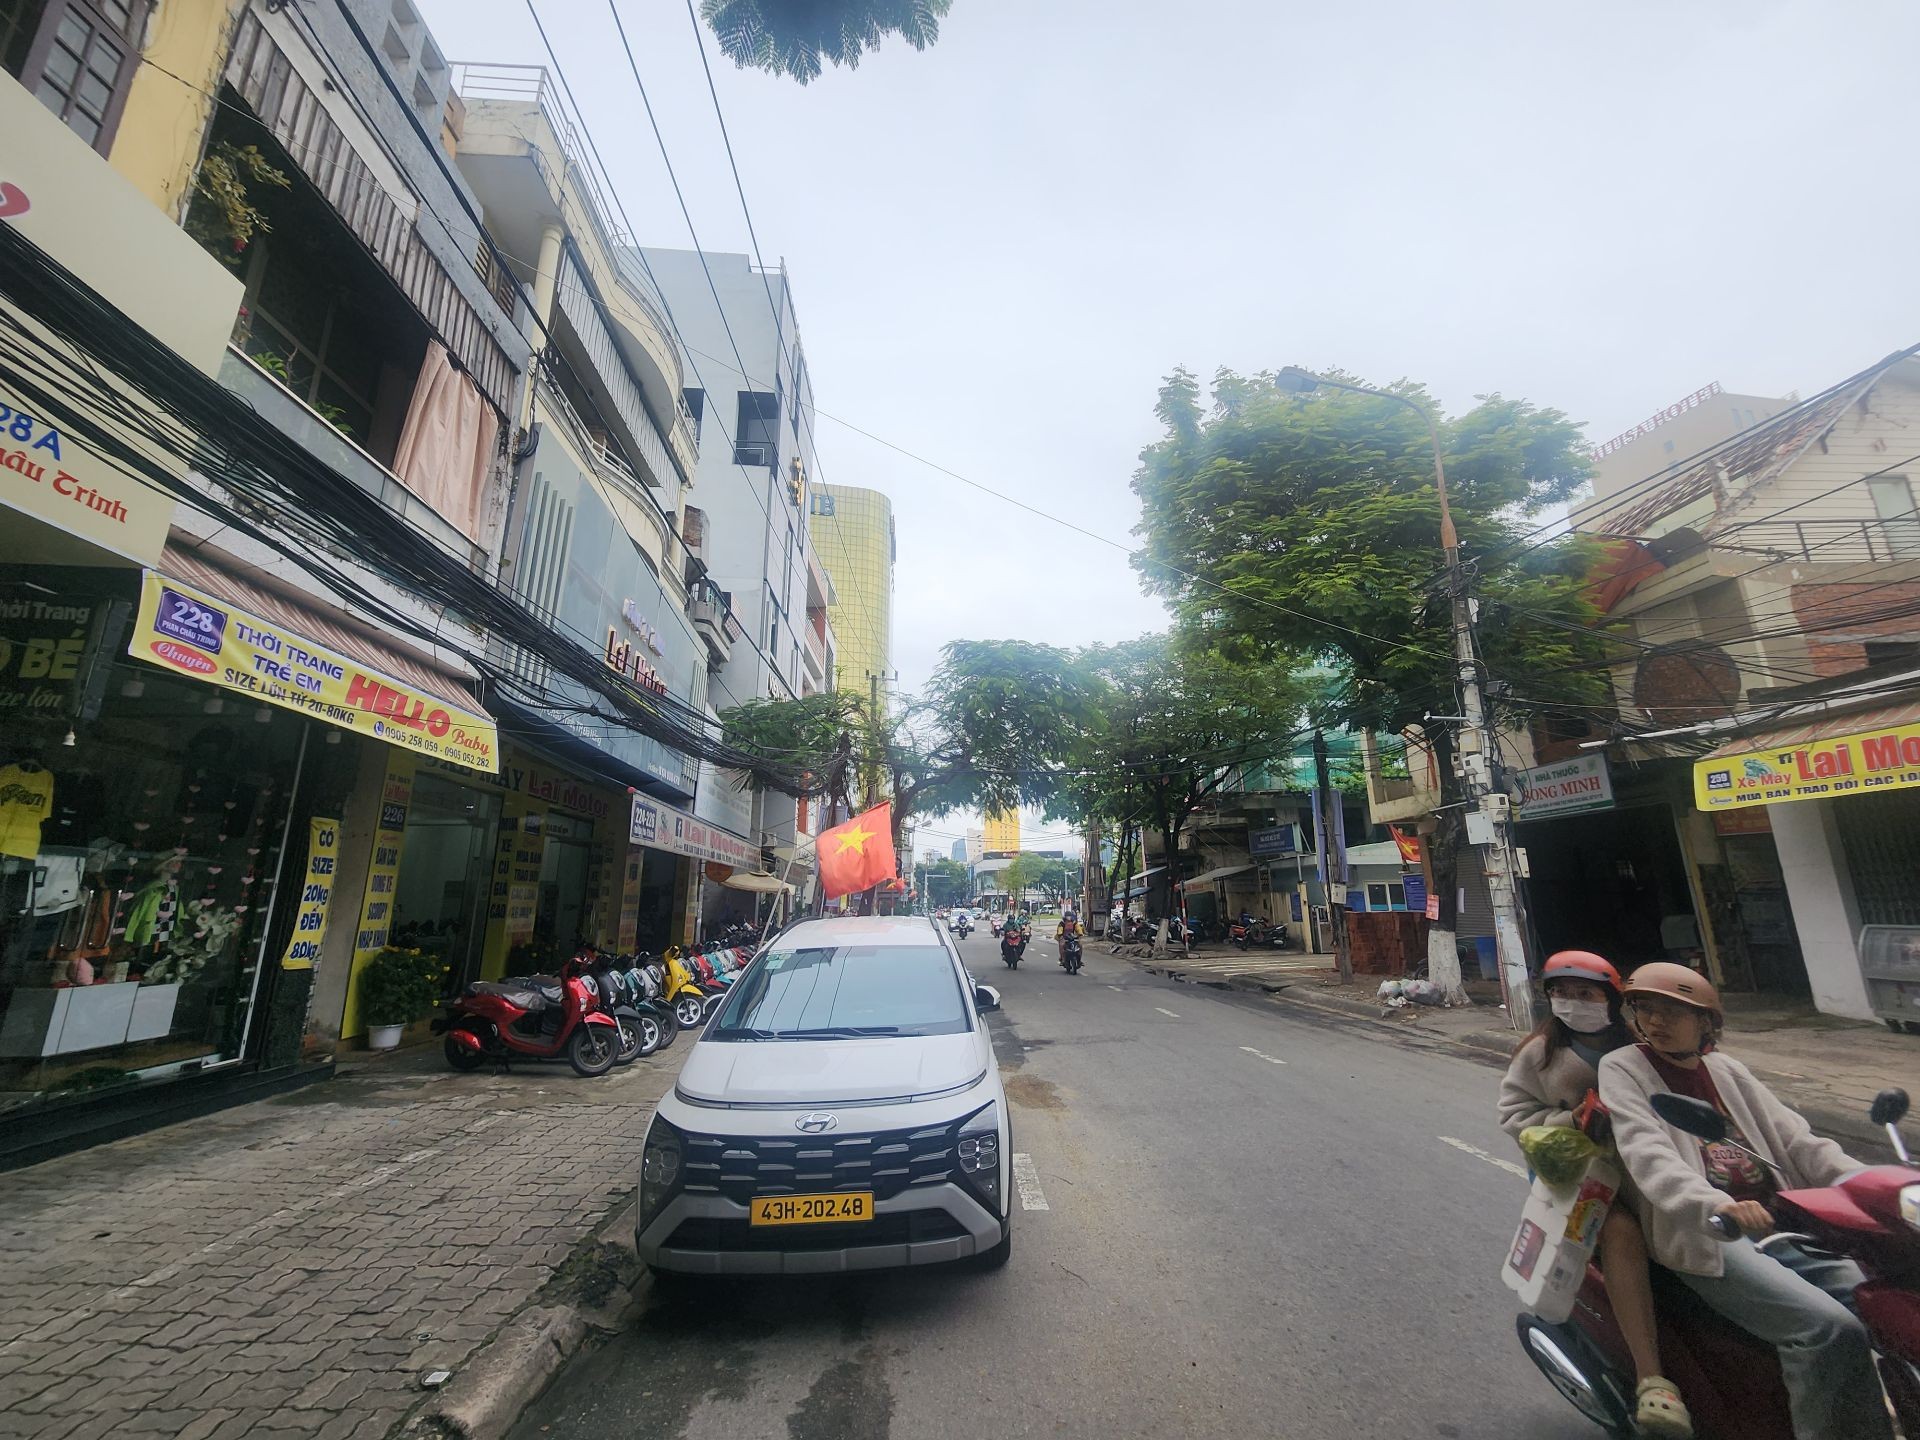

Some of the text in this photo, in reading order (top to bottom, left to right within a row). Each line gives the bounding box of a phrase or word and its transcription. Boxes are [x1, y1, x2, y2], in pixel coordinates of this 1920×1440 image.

[33, 601, 90, 624] Trang
[171, 601, 214, 633] 228
[162, 620, 180, 633] PHAN
[236, 622, 344, 680] THỜI TRANG
[254, 654, 322, 693] TRẺ EM
[224, 667, 259, 691] SIZE
[308, 699, 355, 724] 20-80KG
[344, 673, 451, 738] HELLO
[385, 726, 407, 743] 0905
[408, 734, 423, 748] 258
[425, 739, 438, 753] 059
[444, 746, 461, 760] 0905
[463, 752, 475, 765] 052
[476, 757, 490, 768] 282
[451, 728, 490, 756] Baby
[1795, 744, 1853, 780] Lai
[527, 769, 561, 804] Lai
[1560, 776, 1601, 796] MINH
[1736, 793, 1762, 802] MUA
[1795, 784, 1829, 795] TRAO
[1738, 777, 1756, 788] Xe
[383, 807, 404, 822] 226
[319, 827, 334, 847] CÓ
[311, 856, 334, 874] SIZE
[304, 885, 328, 906] 20kg
[300, 905, 323, 930] ĐẾN
[290, 940, 318, 961] 80kg
[761, 1198, 863, 1220] 43H-202.48
